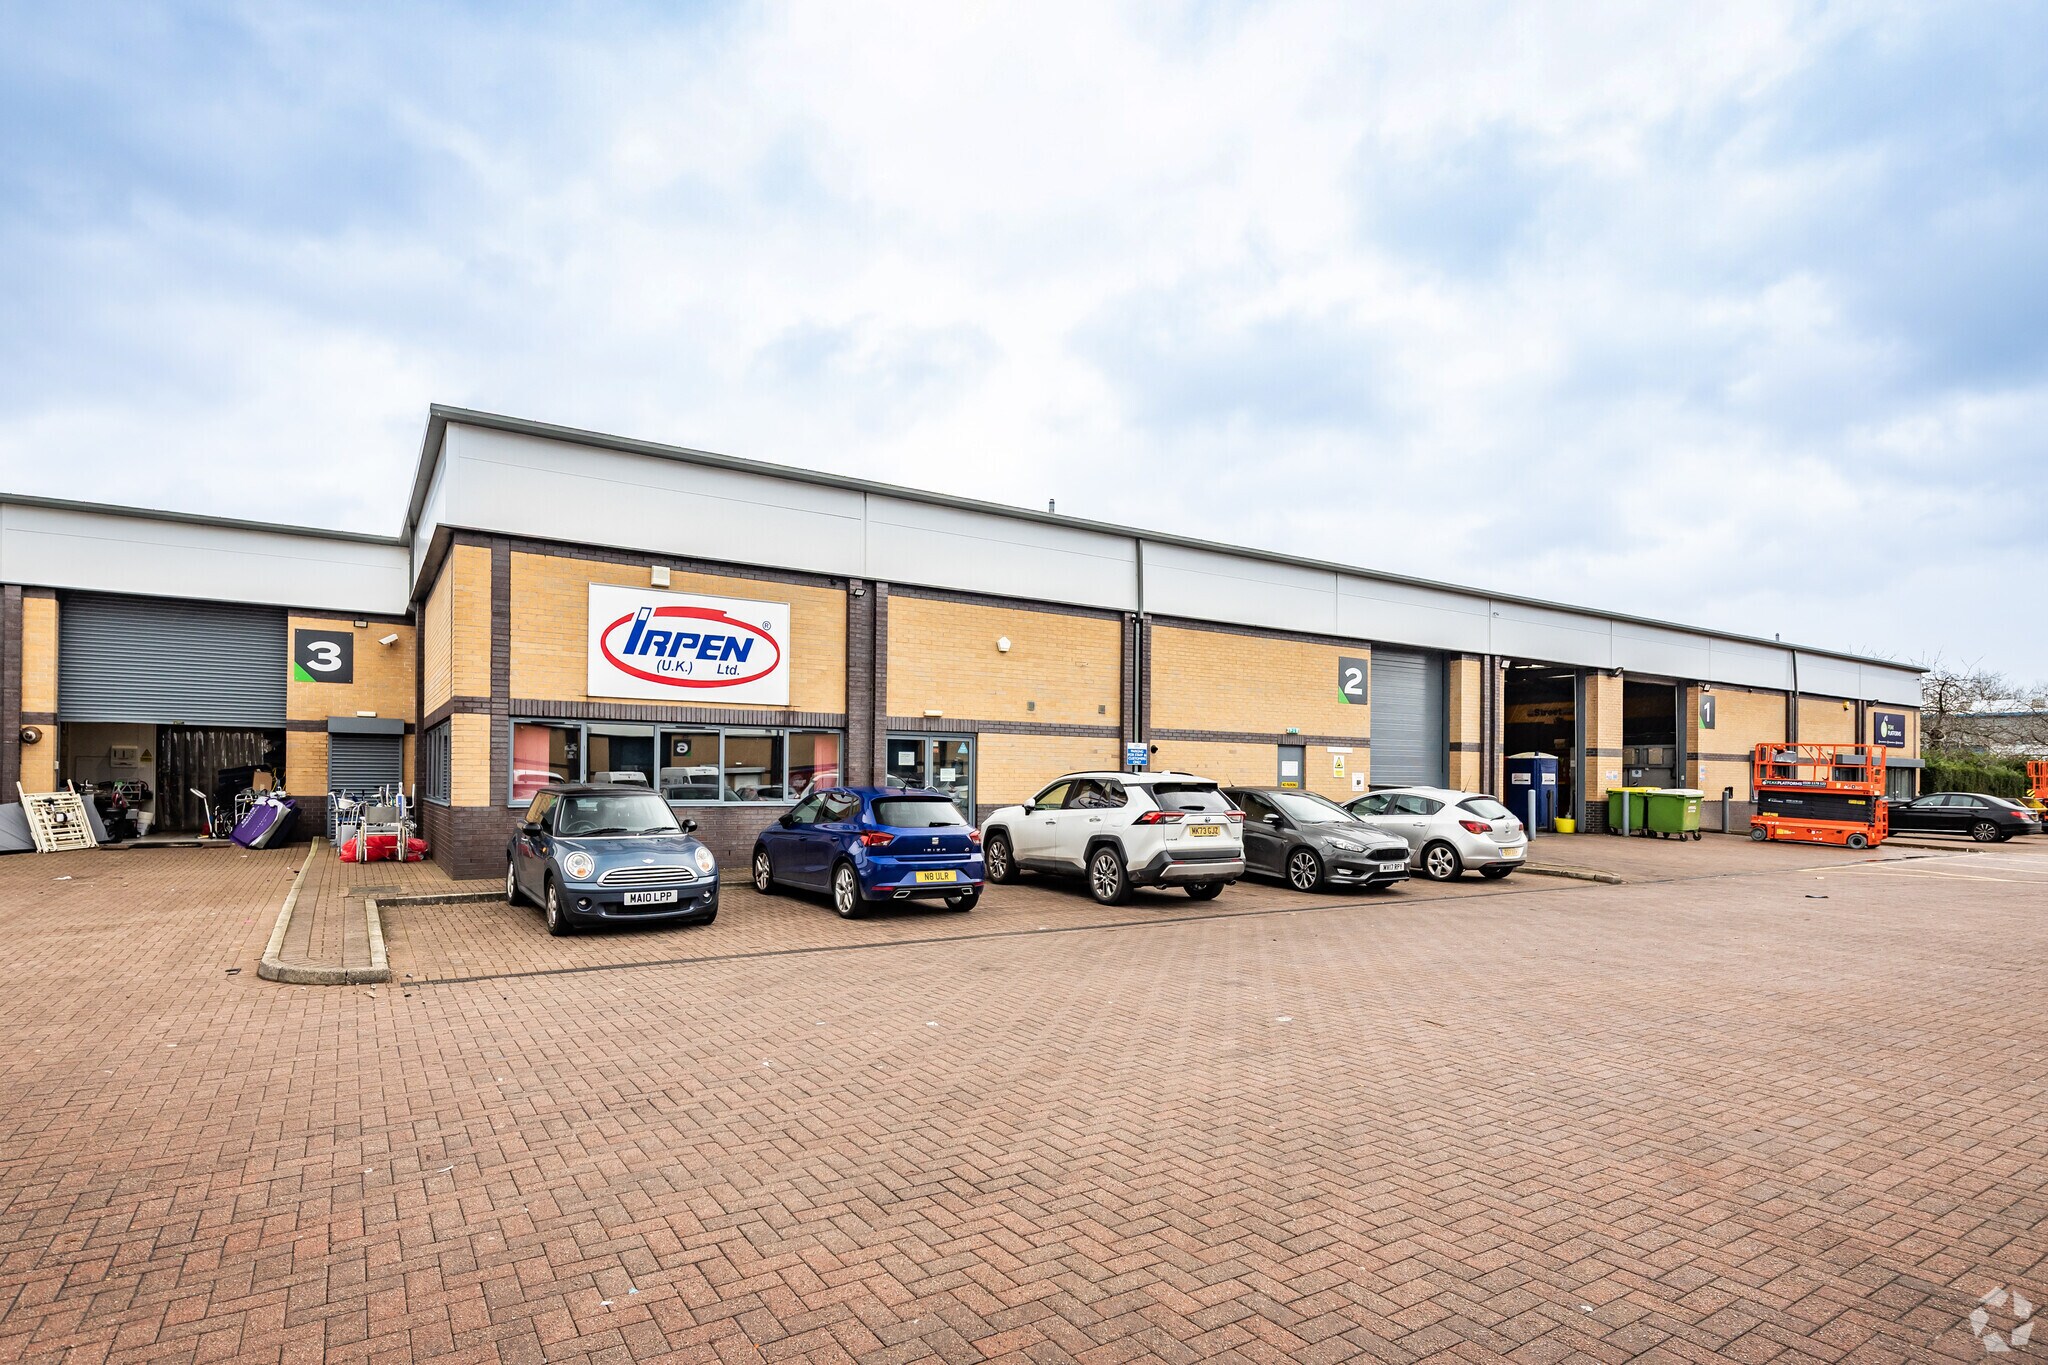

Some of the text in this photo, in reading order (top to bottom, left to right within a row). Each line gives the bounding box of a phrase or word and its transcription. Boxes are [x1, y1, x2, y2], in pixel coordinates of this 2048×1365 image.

[622, 606, 755, 663] IRPEN
[306, 640, 342, 672] 3
[656, 659, 740, 676] (U.K.) Ltd.
[1344, 667, 1363, 695] 2
[1703, 702, 1710, 722] 1
[924, 872, 949, 881] N8 ULR
[630, 891, 672, 903] MA10 LPP
